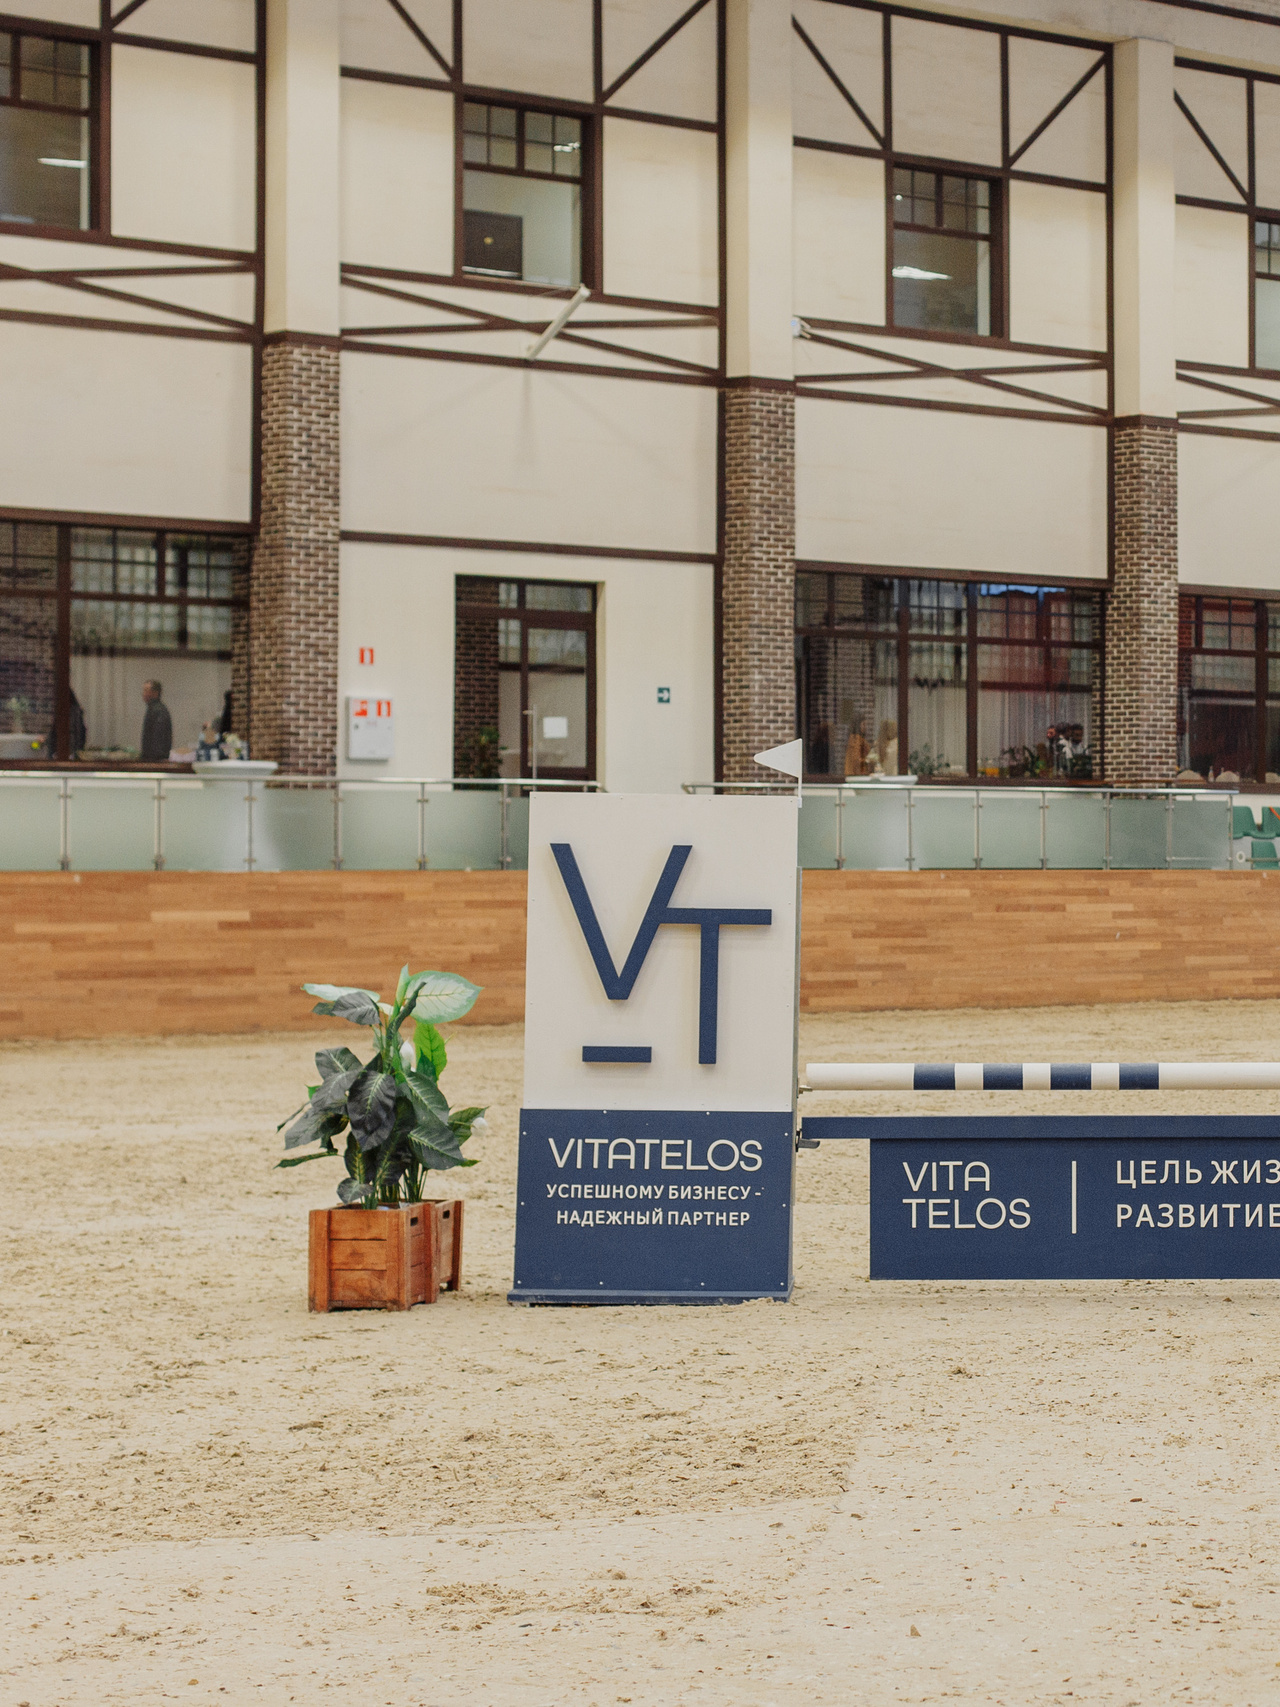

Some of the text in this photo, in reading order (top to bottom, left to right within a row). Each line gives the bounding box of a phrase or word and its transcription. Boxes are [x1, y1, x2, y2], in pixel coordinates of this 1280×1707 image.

[548, 1137, 763, 1172] VITATELOS
[902, 1160, 990, 1192] VITA
[1116, 1159, 1203, 1189] ЦЕЛЬ
[546, 1183, 665, 1200] УСПЕШНОМУ
[668, 1185, 751, 1201] БИЗНЕСУ
[556, 1207, 750, 1228] НАДЕЖНЫЙ ПАРТНЕР
[902, 1197, 1031, 1230] TELOS
